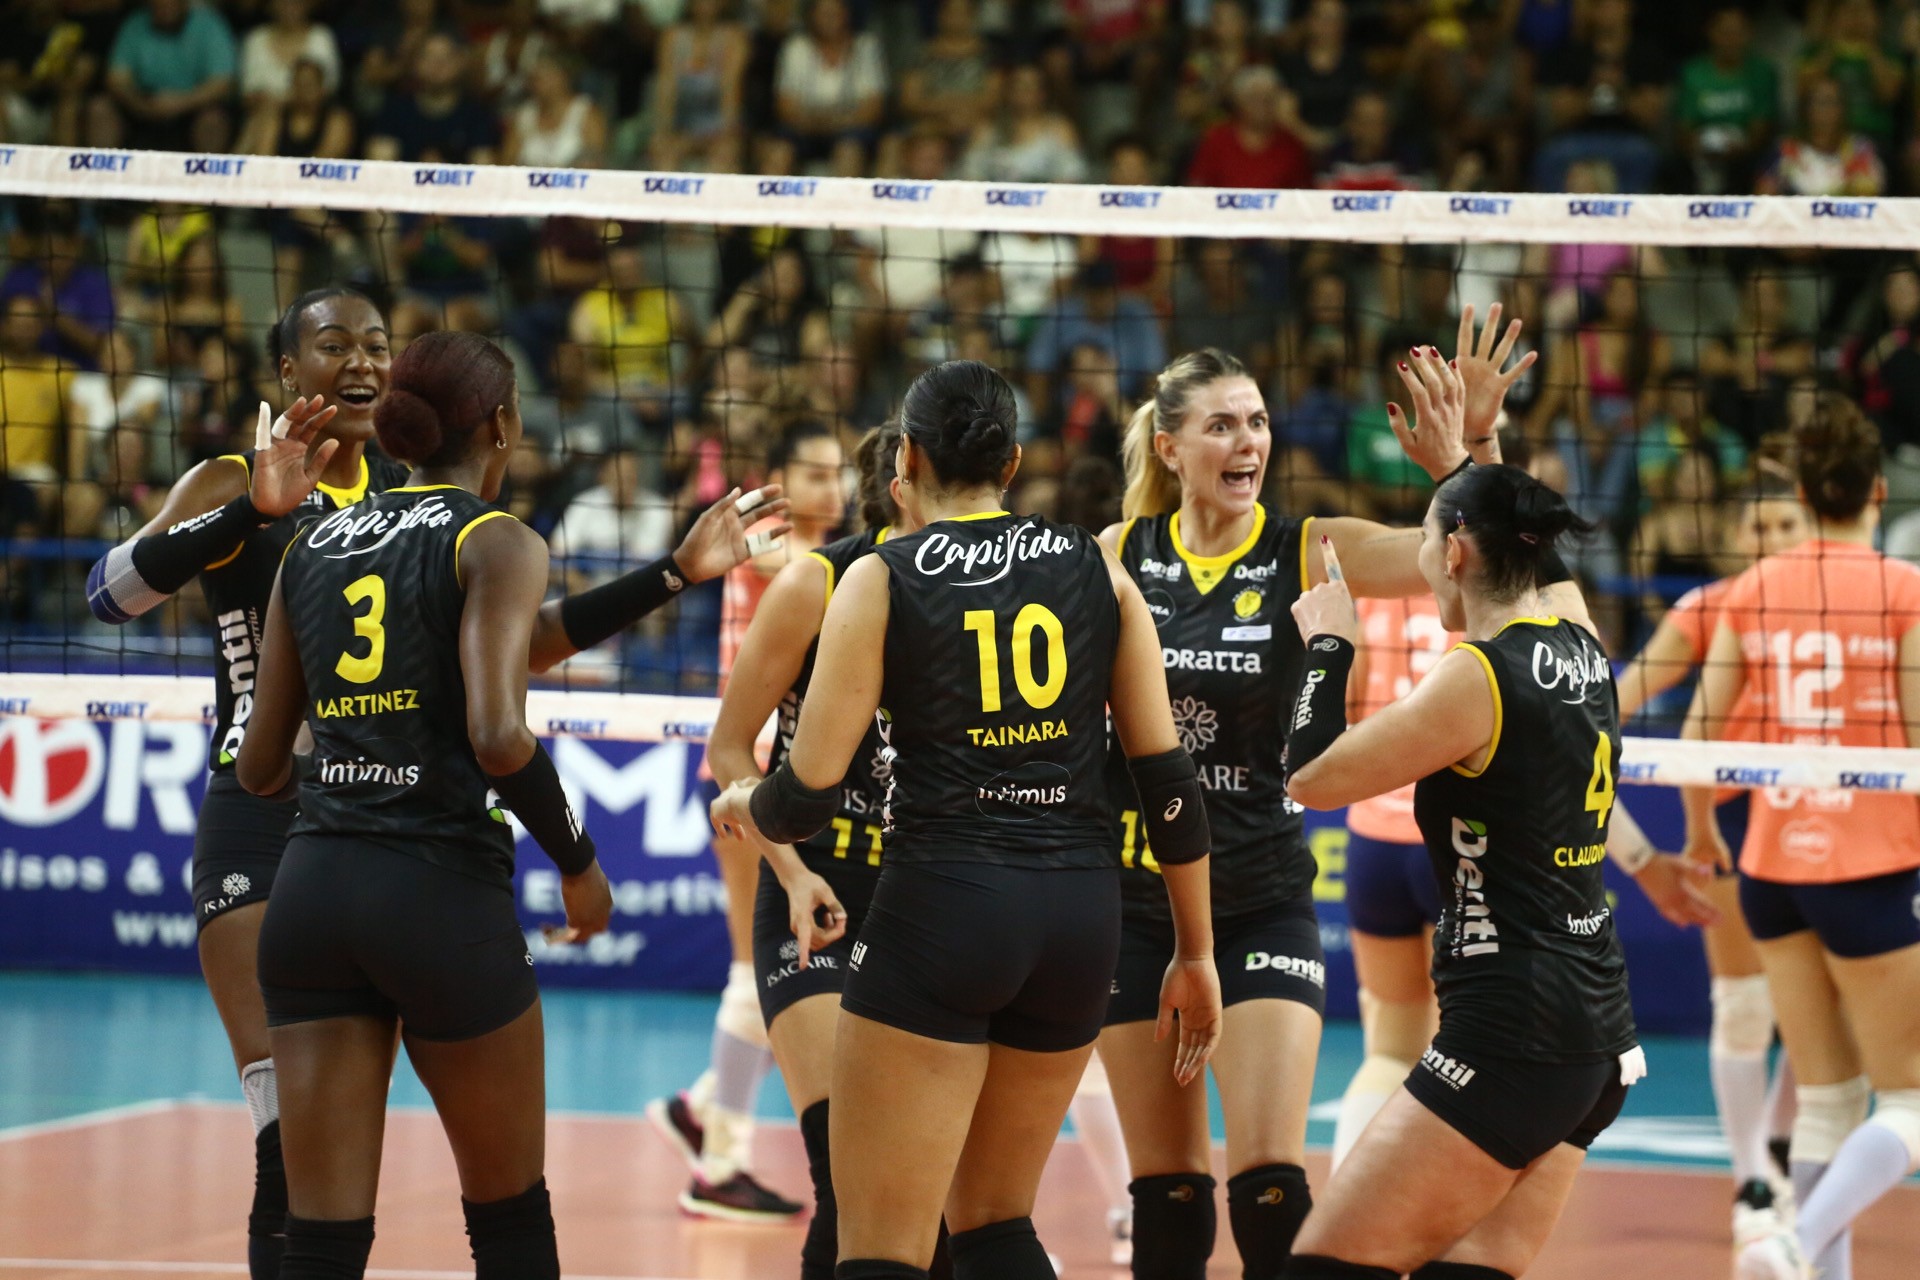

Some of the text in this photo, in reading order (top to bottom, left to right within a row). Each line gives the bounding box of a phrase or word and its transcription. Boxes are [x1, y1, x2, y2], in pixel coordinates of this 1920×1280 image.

[70, 152, 131, 171] 1XBET
[184, 157, 245, 176] 1XBET
[299, 162, 361, 180] 1XBET
[414, 166, 475, 185] 1XBET
[529, 171, 589, 189] 1XBET
[644, 176, 705, 195] 1XBET
[758, 179, 818, 197] 1XBET
[872, 183, 933, 202] 1XBET
[986, 189, 1046, 207] 1XBET
[1103, 191, 1162, 209] 1XBET
[1217, 193, 1279, 211] 1XBET
[1332, 194, 1394, 212] 1XBET
[1452, 197, 1512, 214] 1XBET
[1571, 200, 1632, 217] 1XBET
[1690, 201, 1754, 218] 1XBET
[1811, 202, 1877, 218] 1XBET
[914, 521, 1074, 587] CapiVida
[335, 574, 386, 684] 3
[964, 603, 1068, 713] 10
[1773, 628, 1845, 728] 12
[1295, 669, 1327, 731] Dentil
[86, 702, 149, 718] 1XBET
[547, 719, 608, 735] 1XBET
[966, 720, 1069, 748] TAINARA
[320, 757, 419, 787] Intimus
[1585, 730, 1615, 829] 4
[1715, 766, 1782, 786] 1XBET
[1837, 771, 1906, 789] 1XBET
[977, 784, 1067, 806] Intimus
[1451, 816, 1500, 958] Dentl
